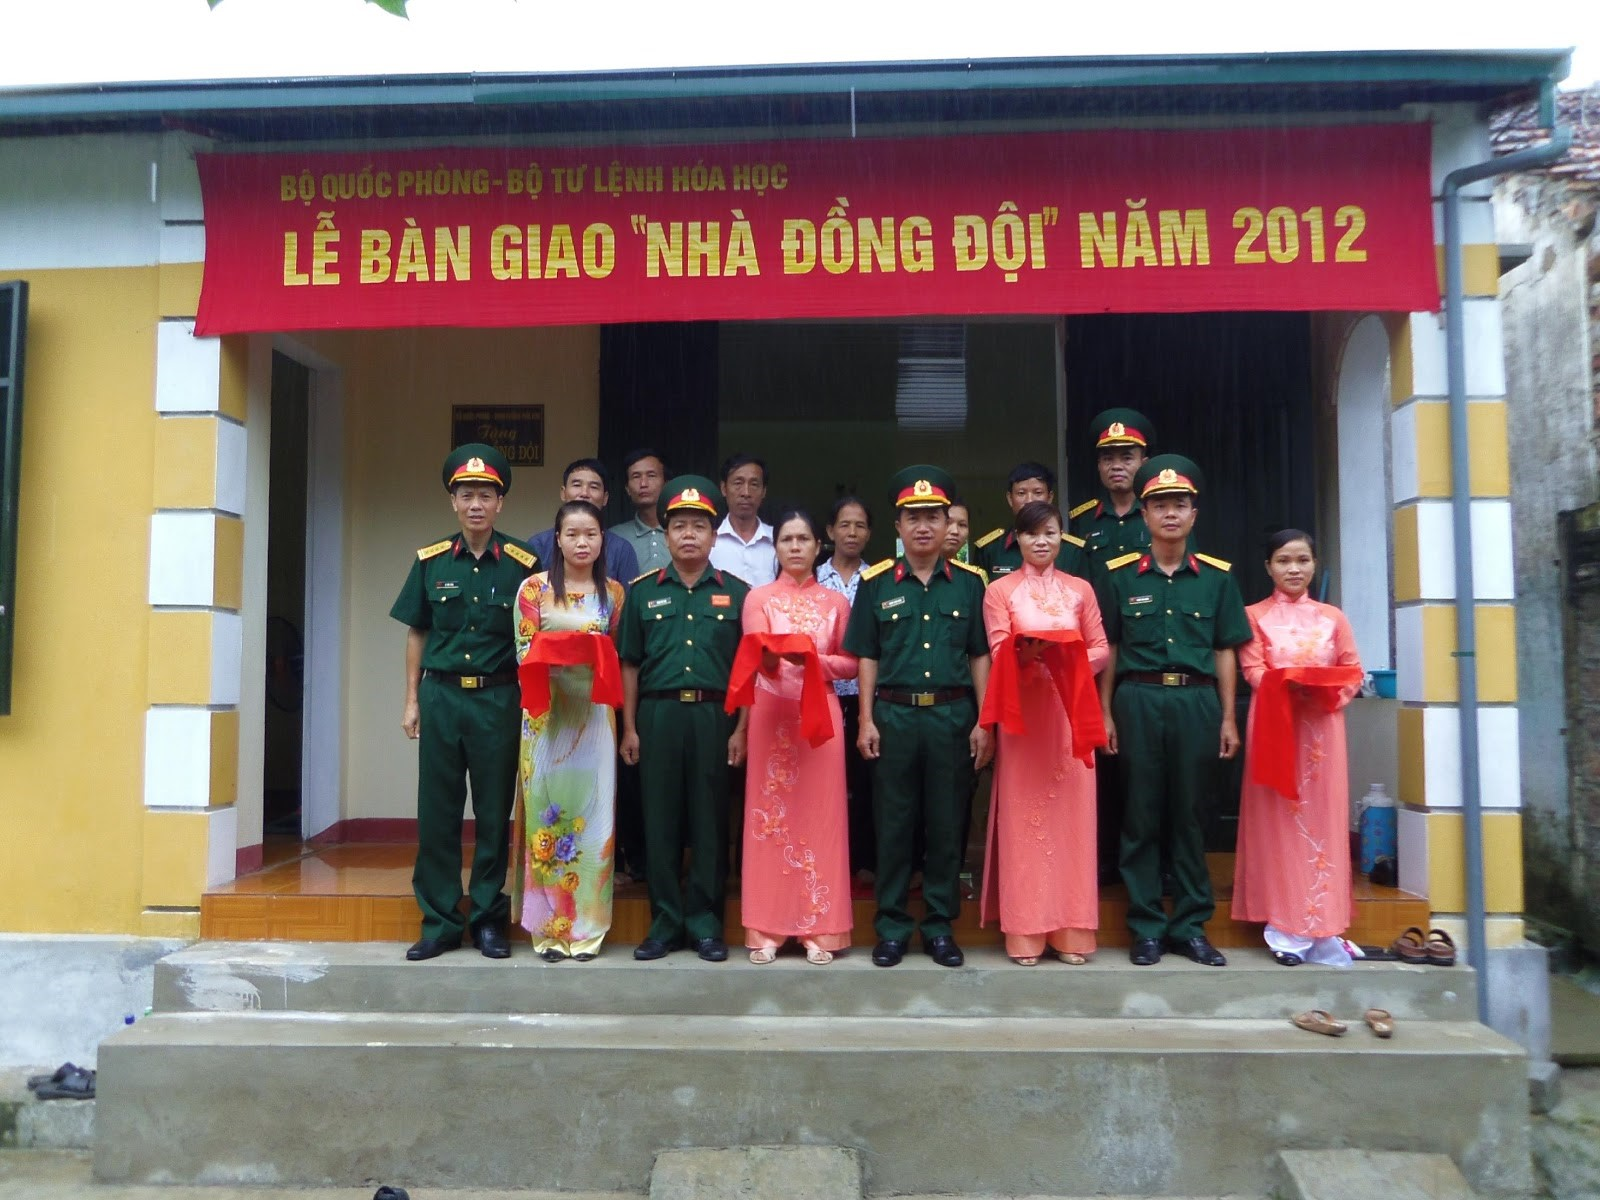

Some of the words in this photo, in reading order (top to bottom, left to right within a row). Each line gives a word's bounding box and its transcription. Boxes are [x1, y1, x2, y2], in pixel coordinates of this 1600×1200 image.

[281, 169, 315, 206] BỘ
[322, 164, 392, 202] QUỐC
[551, 164, 587, 193] TƯ
[595, 160, 663, 197] LỆNH
[672, 160, 726, 192] HÓA
[733, 163, 788, 196] HỌC
[284, 211, 340, 286] LỄ
[360, 218, 470, 283] BÀN
[491, 223, 615, 280] GIAO
[781, 197, 934, 274] ĐỒNG
[1080, 198, 1210, 268] NĂM
[1233, 205, 1368, 264] 2012
